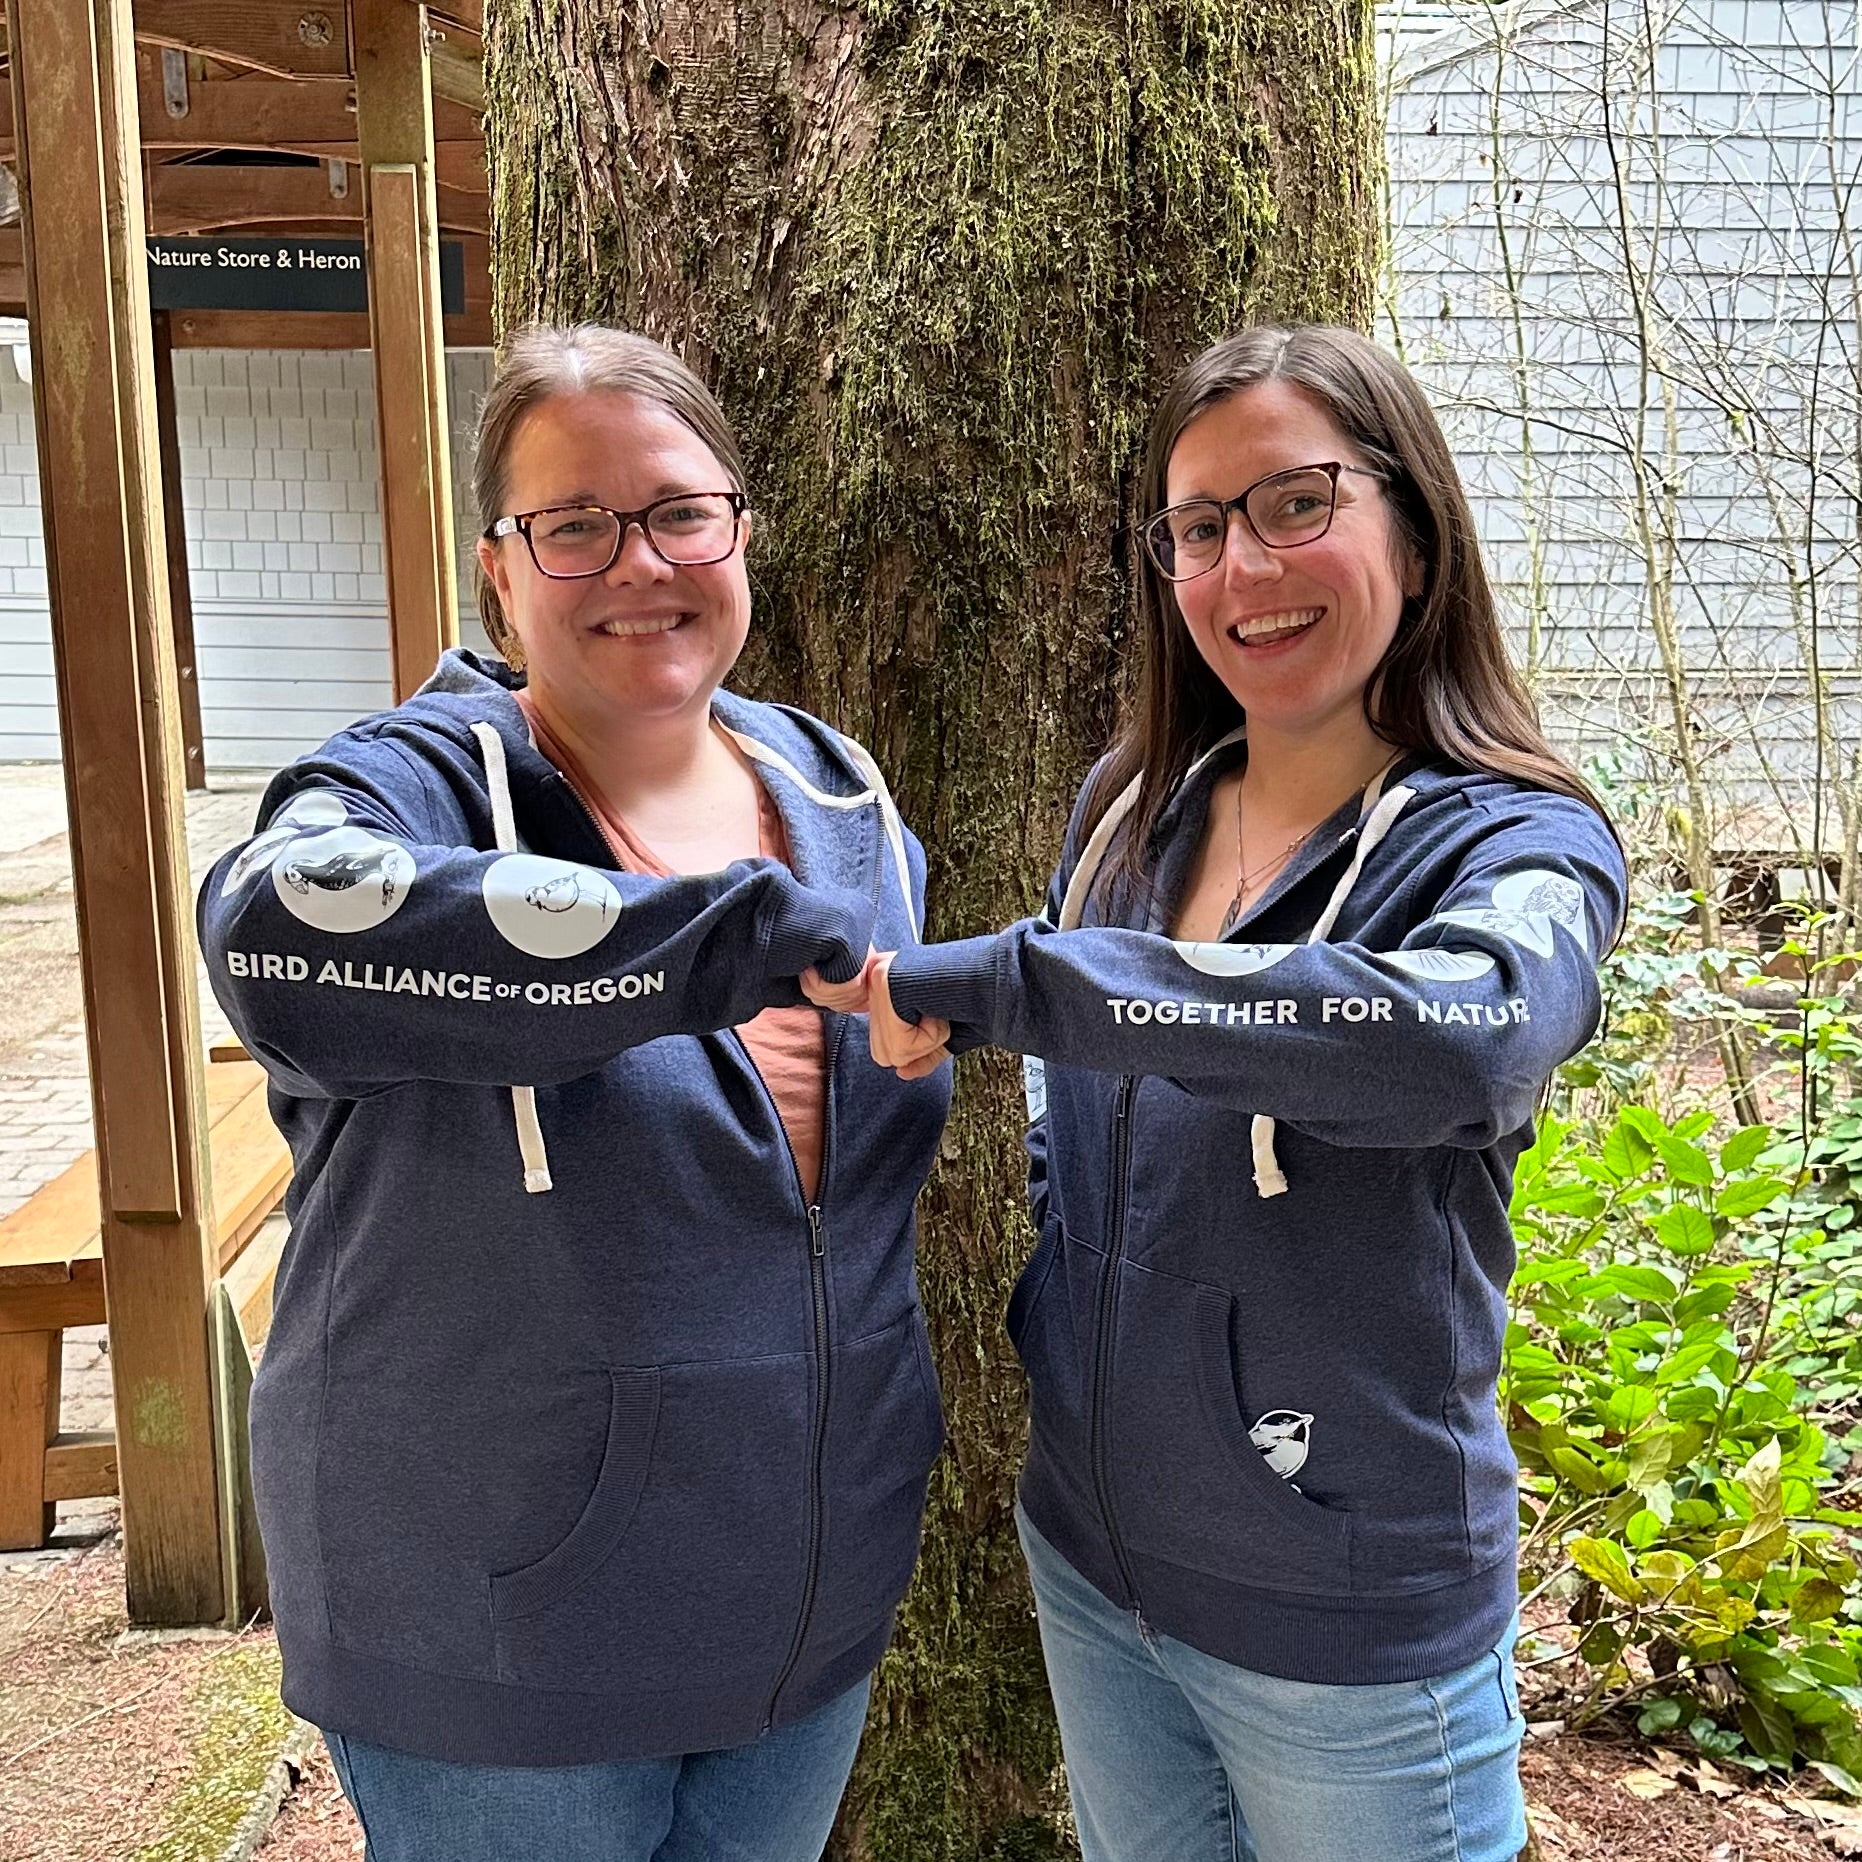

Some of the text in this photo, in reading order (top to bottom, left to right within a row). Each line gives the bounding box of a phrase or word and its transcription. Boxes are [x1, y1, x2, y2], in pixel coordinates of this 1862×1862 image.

[146, 246, 361, 270] Nature Store & Heron
[227, 950, 665, 1005] BIRD ALLIANCE OF OREGON
[1106, 998, 1298, 1025] TOGETHER
[1322, 997, 1393, 1023] FOR
